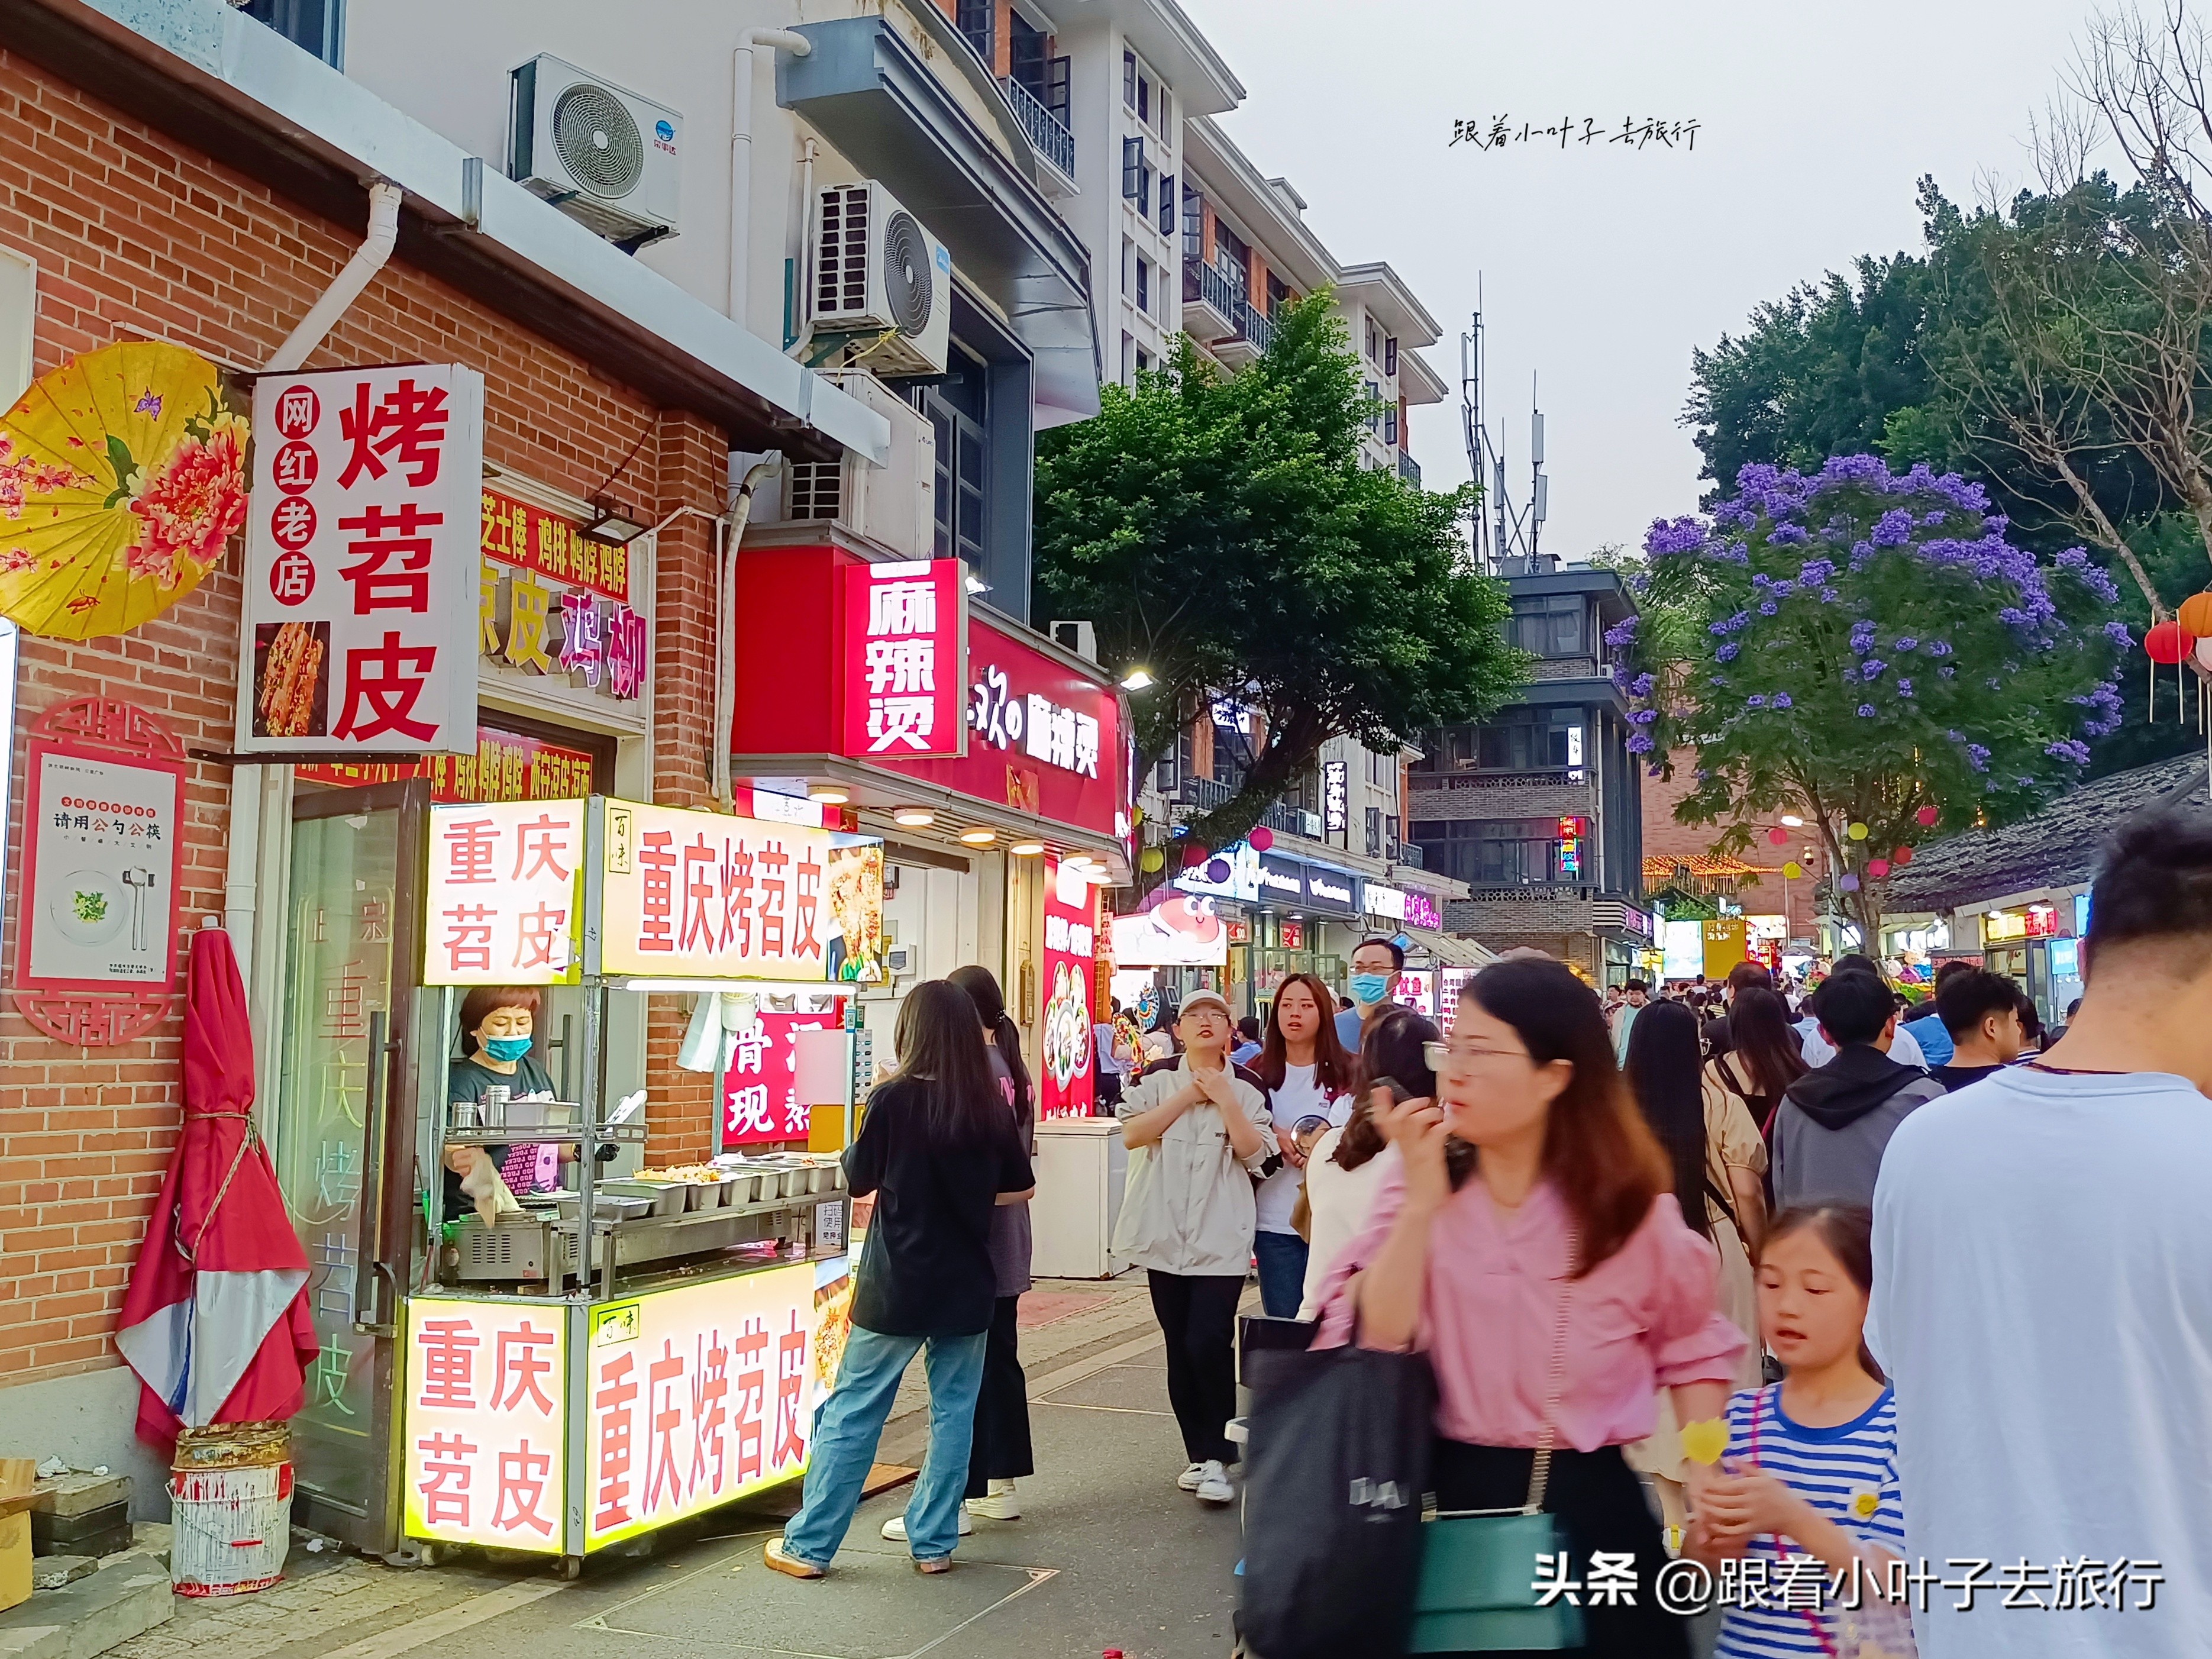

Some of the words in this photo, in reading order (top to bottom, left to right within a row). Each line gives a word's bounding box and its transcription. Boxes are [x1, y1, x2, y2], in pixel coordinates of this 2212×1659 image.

[275, 391, 314, 598] 网红老店
[481, 493, 527, 561] 芝士棒
[538, 517, 567, 576] 鸡排
[331, 379, 449, 743] 烤苕皮
[865, 580, 935, 751] 麻辣烫
[967, 664, 1099, 780] 欢の麻辣烫
[53, 812, 161, 841] 请用公勺公筷
[444, 814, 570, 886] 重庆
[443, 900, 566, 971] 苕皮
[639, 830, 822, 960] 重庆烤苕皮
[314, 959, 368, 1415] 重庆烤苕皮
[419, 1319, 553, 1416] 重庆
[596, 1309, 807, 1532] 重庆烤苕皮
[418, 1432, 553, 1537] 苕皮
